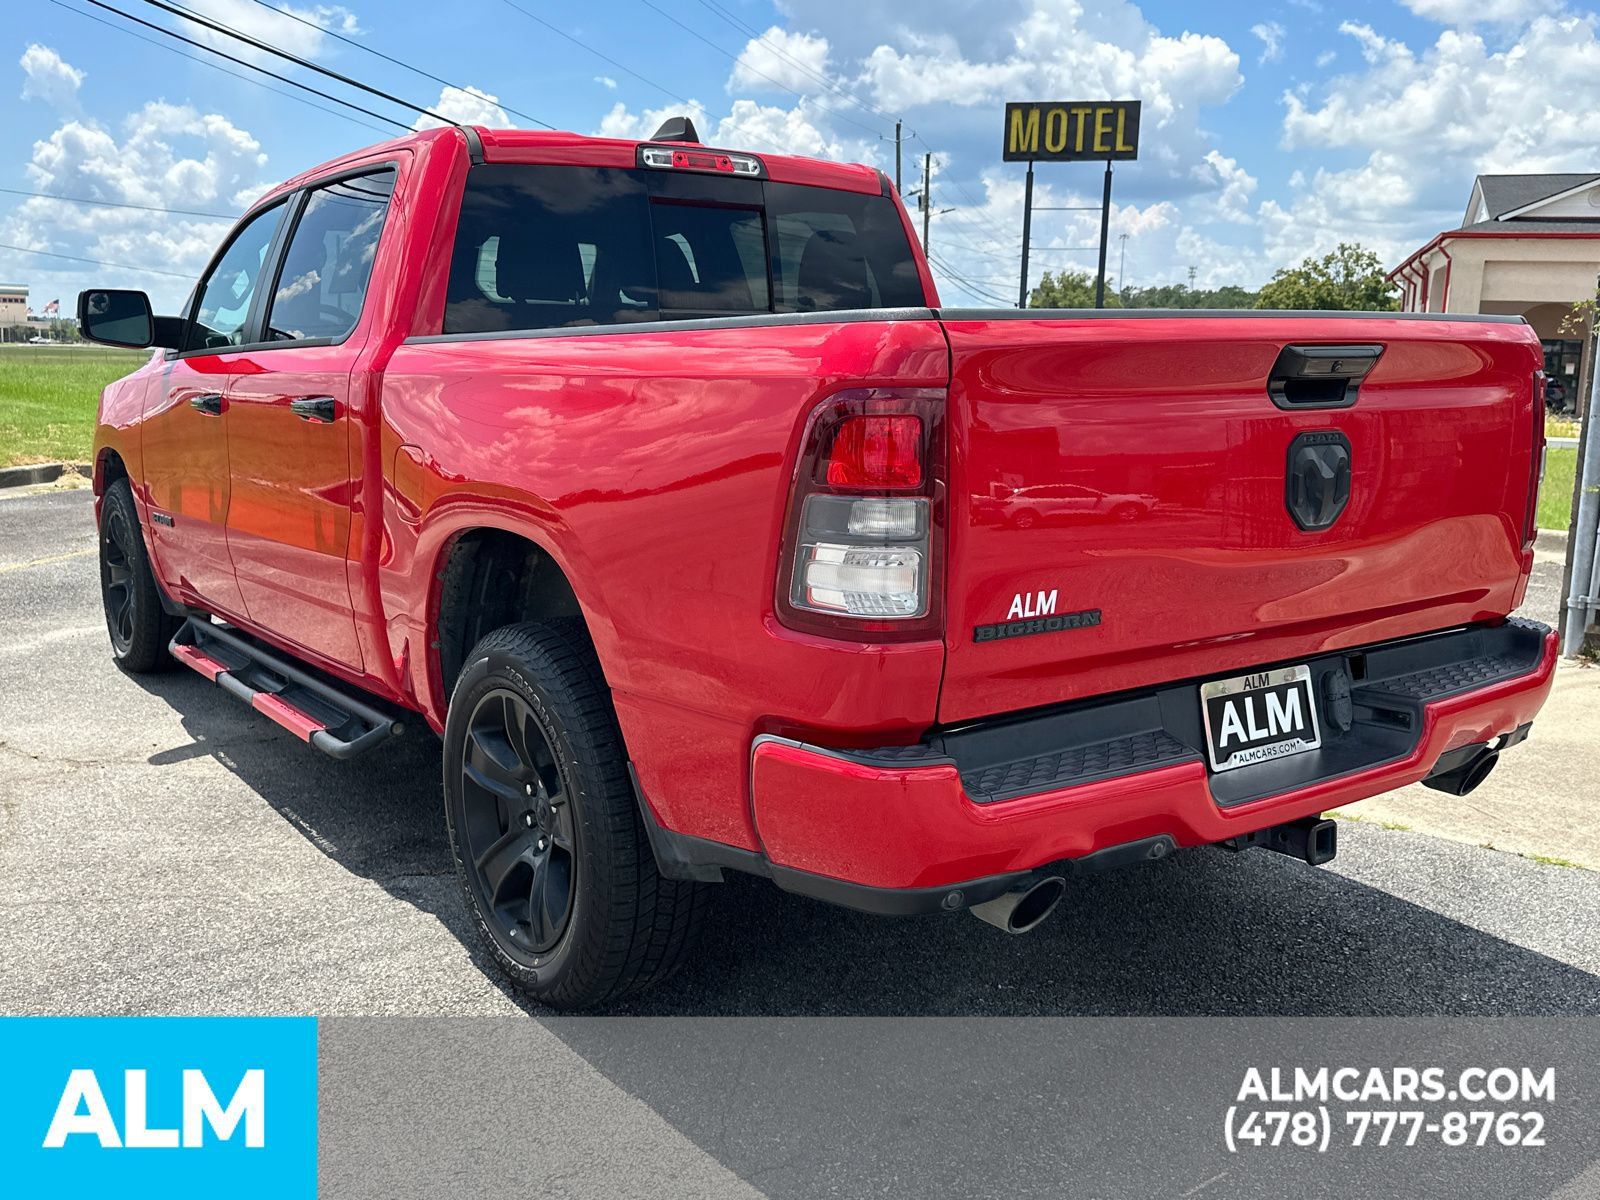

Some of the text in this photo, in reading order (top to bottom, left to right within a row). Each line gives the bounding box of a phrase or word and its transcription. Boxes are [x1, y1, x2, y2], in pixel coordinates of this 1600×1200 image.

[1009, 107, 1134, 153] MOTEL
[1006, 589, 1058, 620] ALM
[1243, 673, 1270, 691] ALM
[1219, 687, 1304, 748] ALM
[1238, 741, 1297, 764] ALMCARS.COM
